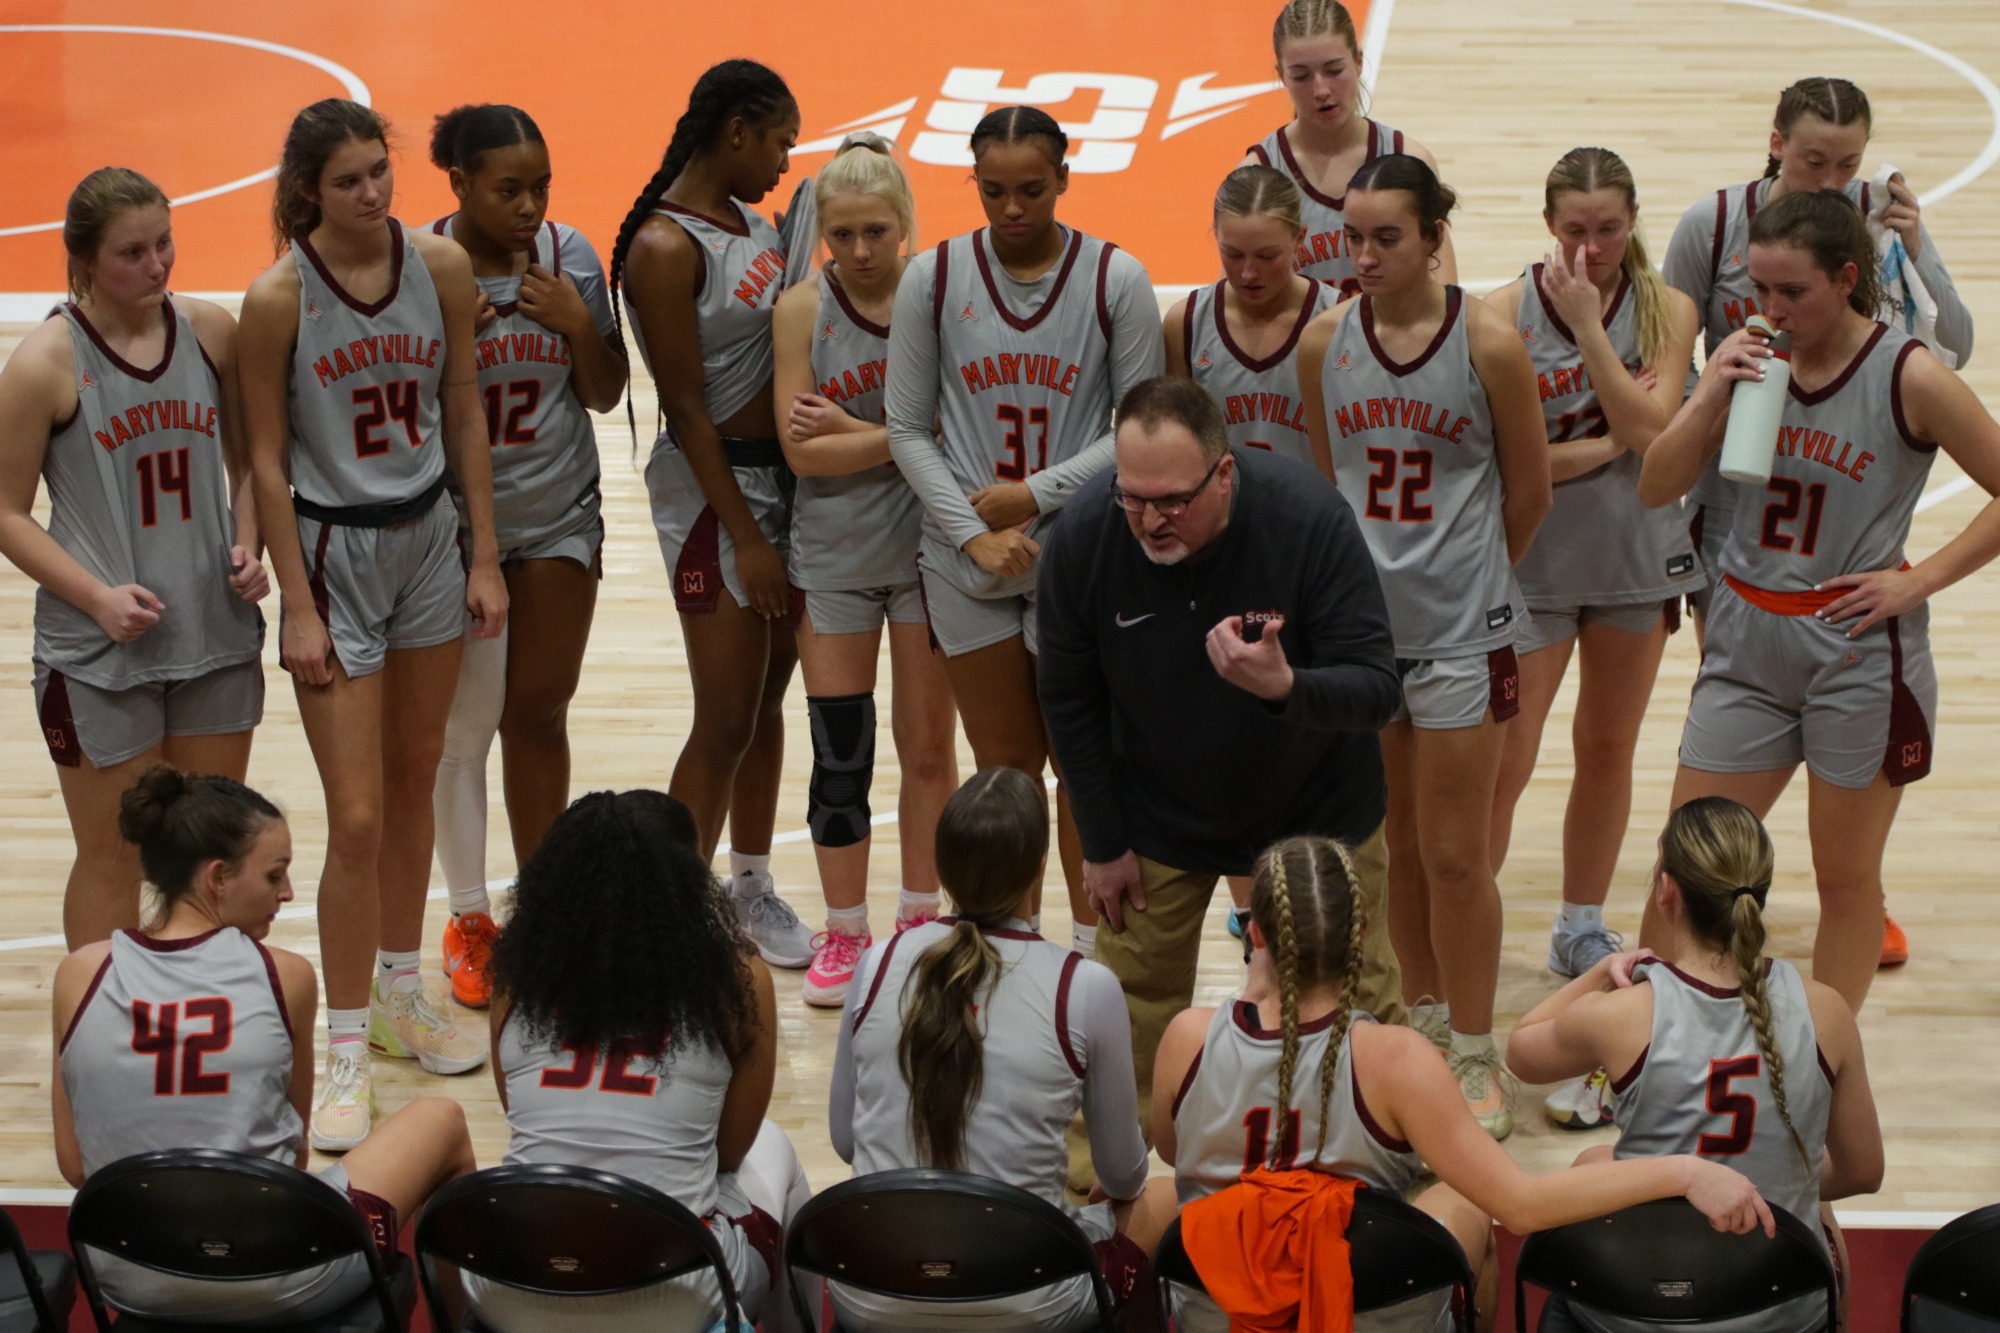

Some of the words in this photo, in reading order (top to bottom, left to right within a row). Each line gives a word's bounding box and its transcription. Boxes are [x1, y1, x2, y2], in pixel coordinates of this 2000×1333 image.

[1292, 225, 1350, 272] ARY
[1723, 297, 1765, 330] MA
[312, 333, 441, 389] MARYVILLE
[476, 333, 569, 371] RYVILLE
[1537, 363, 1594, 403] ARY
[351, 378, 423, 459] 24
[483, 378, 542, 447] 12
[1223, 392, 1309, 435] RYVILL
[1335, 397, 1472, 445] MARYVILLE
[136, 446, 193, 528] 14
[1364, 446, 1433, 523] 22
[1760, 475, 1827, 558] 21
[682, 571, 705, 594] M
[1902, 740, 1922, 767] M
[131, 996, 233, 1096] 42
[1696, 1054, 1761, 1156] 5
[1241, 1106, 1301, 1176] 11
